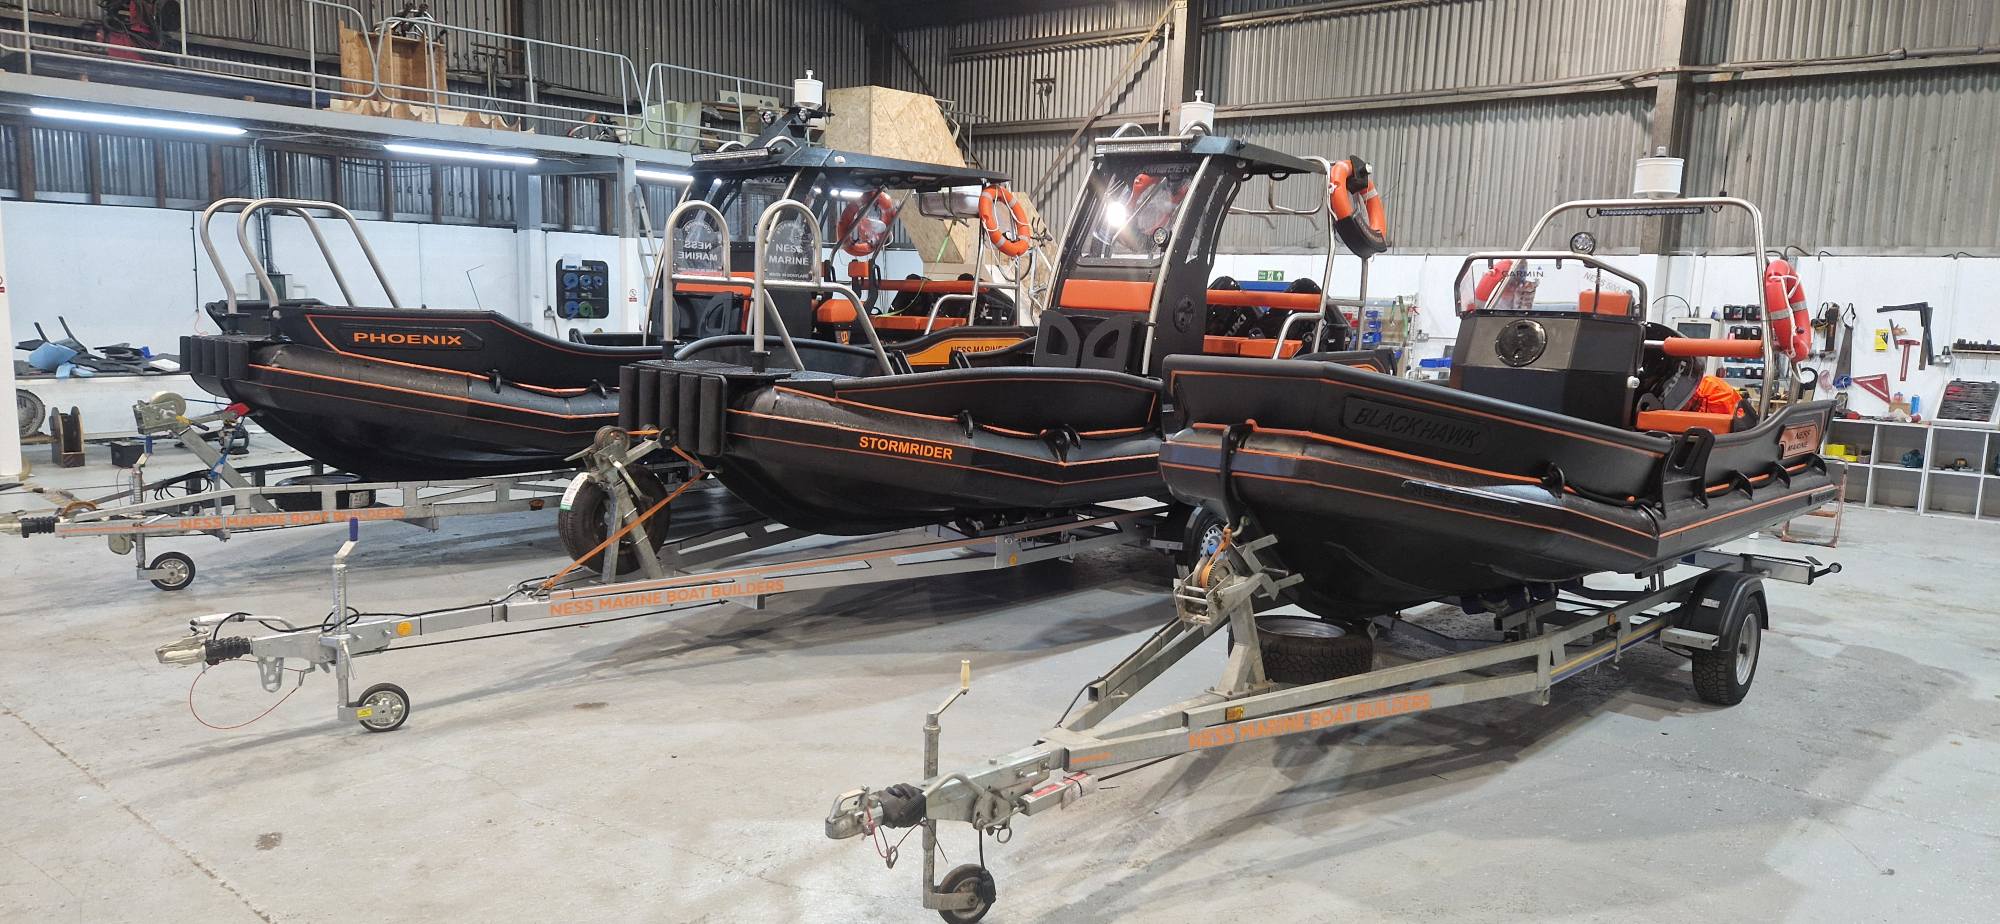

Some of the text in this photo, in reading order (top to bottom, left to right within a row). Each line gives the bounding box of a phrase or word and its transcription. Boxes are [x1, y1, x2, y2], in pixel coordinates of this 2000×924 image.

[775, 243, 804, 253] NESS
[769, 255, 809, 265] MARINE
[1501, 270, 1544, 278] GARMIN
[1583, 271, 1606, 287] NES
[353, 332, 462, 345] PHOENIX
[1795, 430, 1811, 440] NESS
[859, 436, 953, 460] STORMRIDER
[179, 507, 405, 530] NESS MARINE BOAT BUILDERS
[550, 579, 785, 616] NESS MARINE BOAT BUILDERS
[1189, 692, 1432, 750] NESS MARINE BOAT BUILDERS
